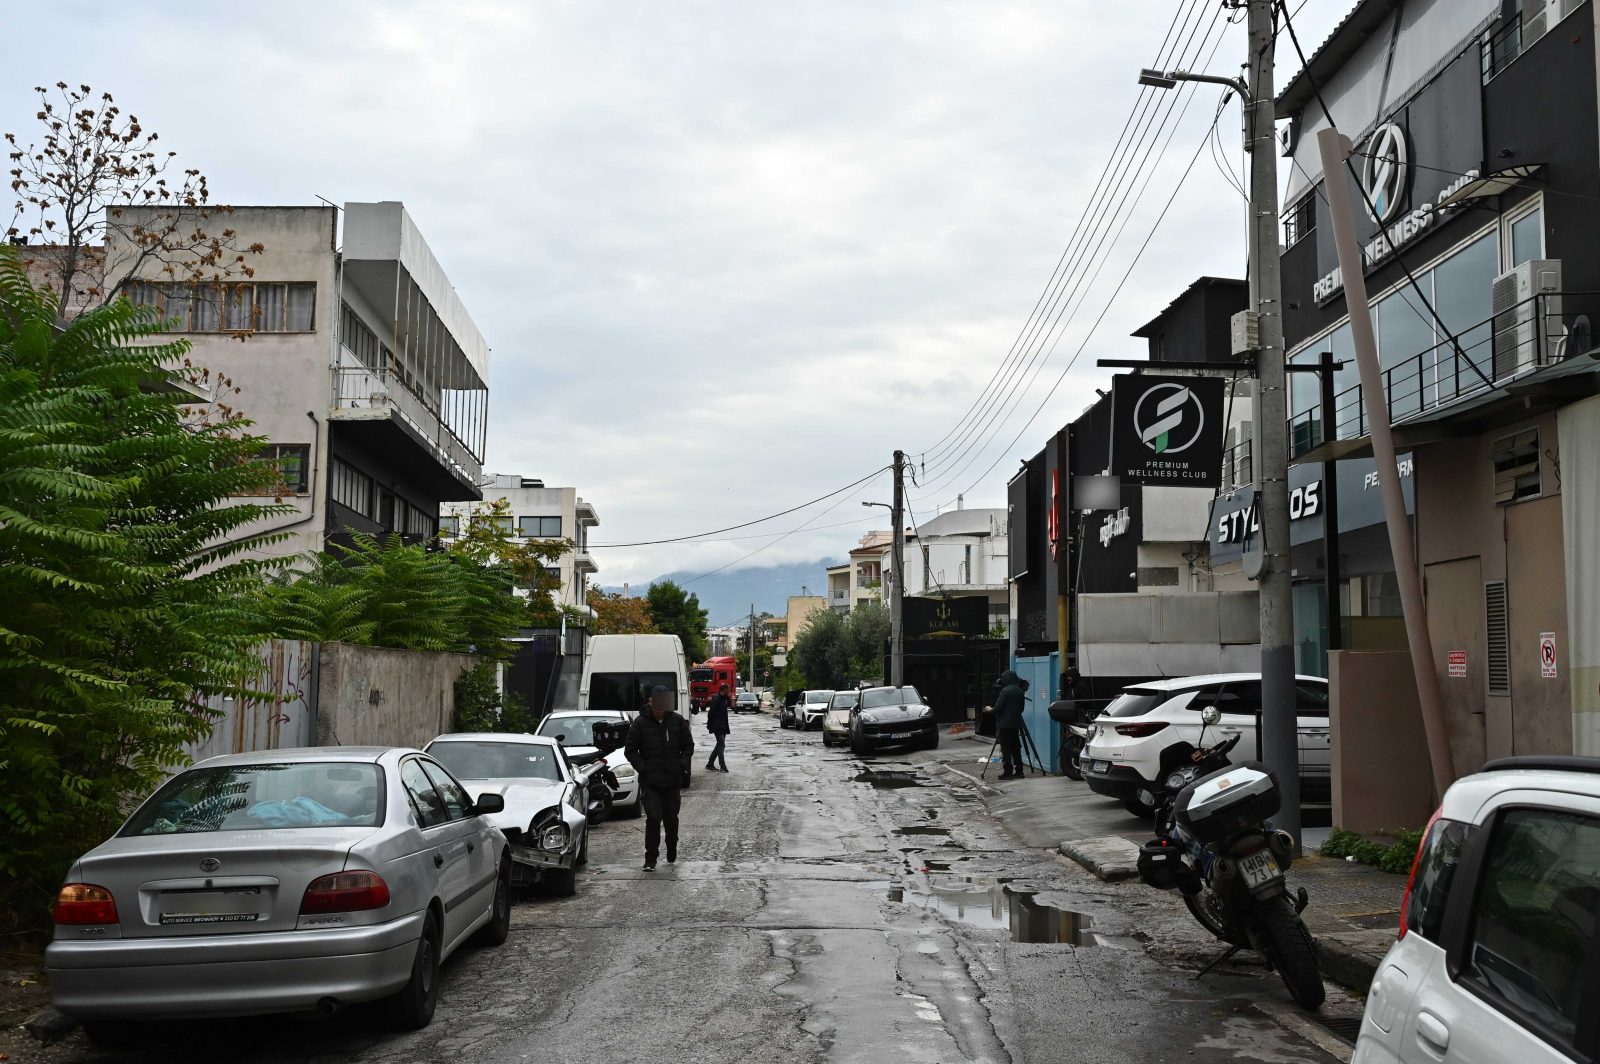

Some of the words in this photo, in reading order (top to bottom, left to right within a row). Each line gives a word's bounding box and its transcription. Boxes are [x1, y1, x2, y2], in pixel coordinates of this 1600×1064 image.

[1146, 461, 1189, 469] PREMIUM
[1128, 469, 1178, 478] WELLNESS
[1182, 470, 1207, 478] CLUB
